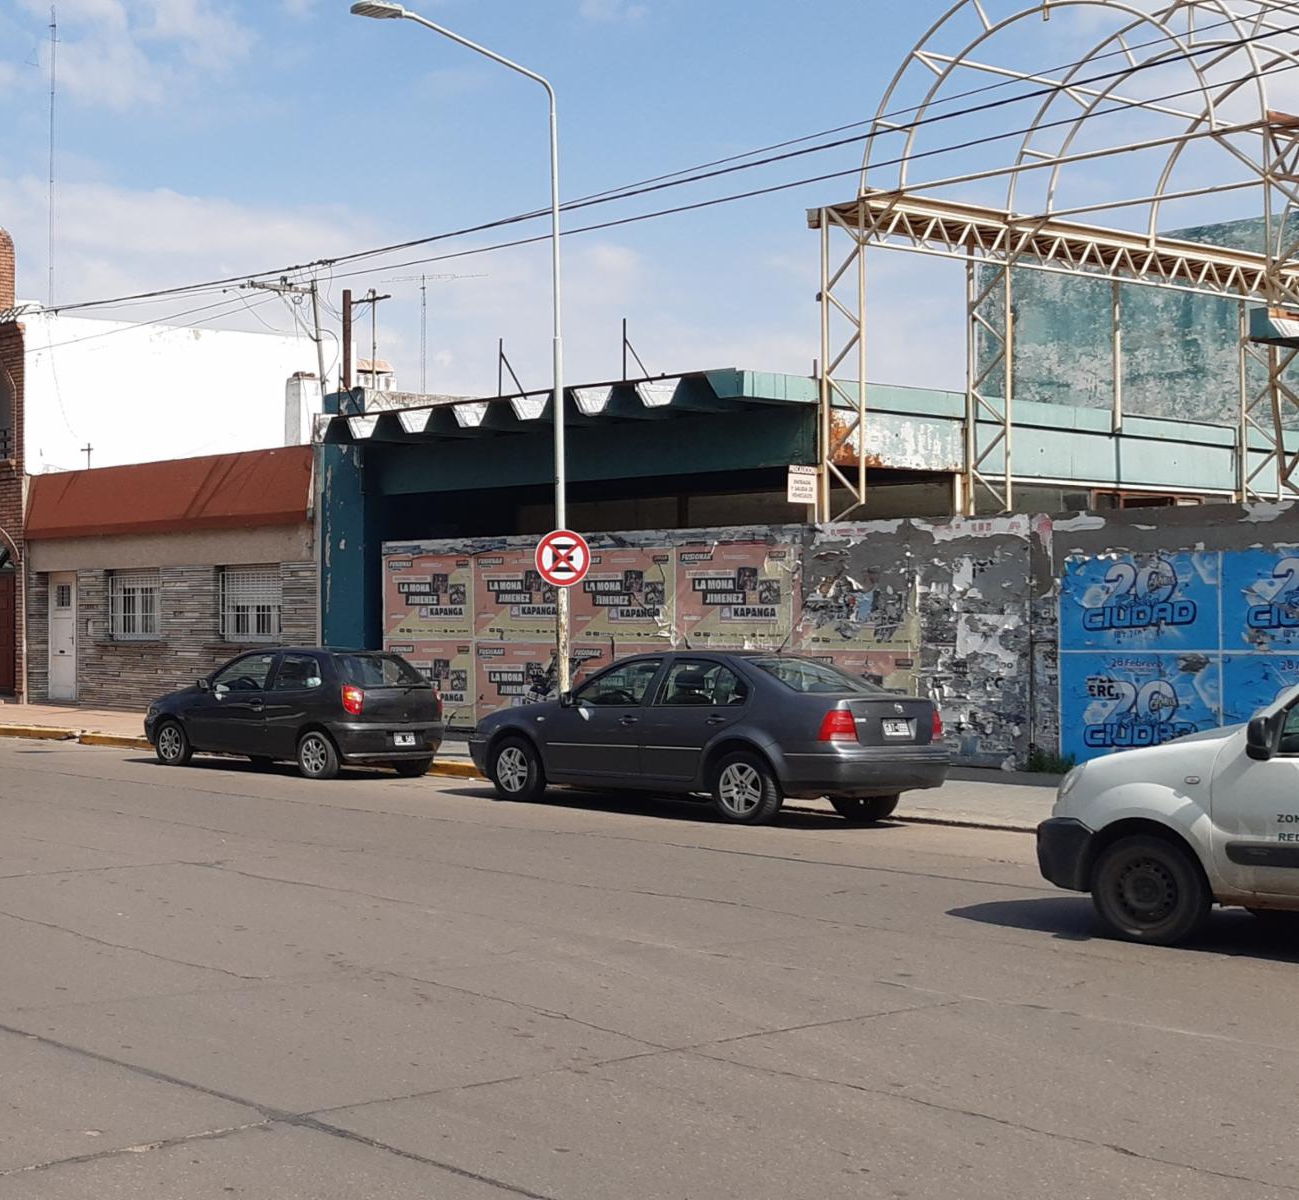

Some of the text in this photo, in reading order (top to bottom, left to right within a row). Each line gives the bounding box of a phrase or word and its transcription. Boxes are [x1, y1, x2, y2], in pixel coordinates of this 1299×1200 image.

[400, 583, 408, 592] LA
[489, 581, 498, 590] LA
[585, 581, 595, 591] LA
[694, 579, 705, 589] LA
[1082, 600, 1198, 631] CIUDAD
[491, 672, 501, 681] LA
